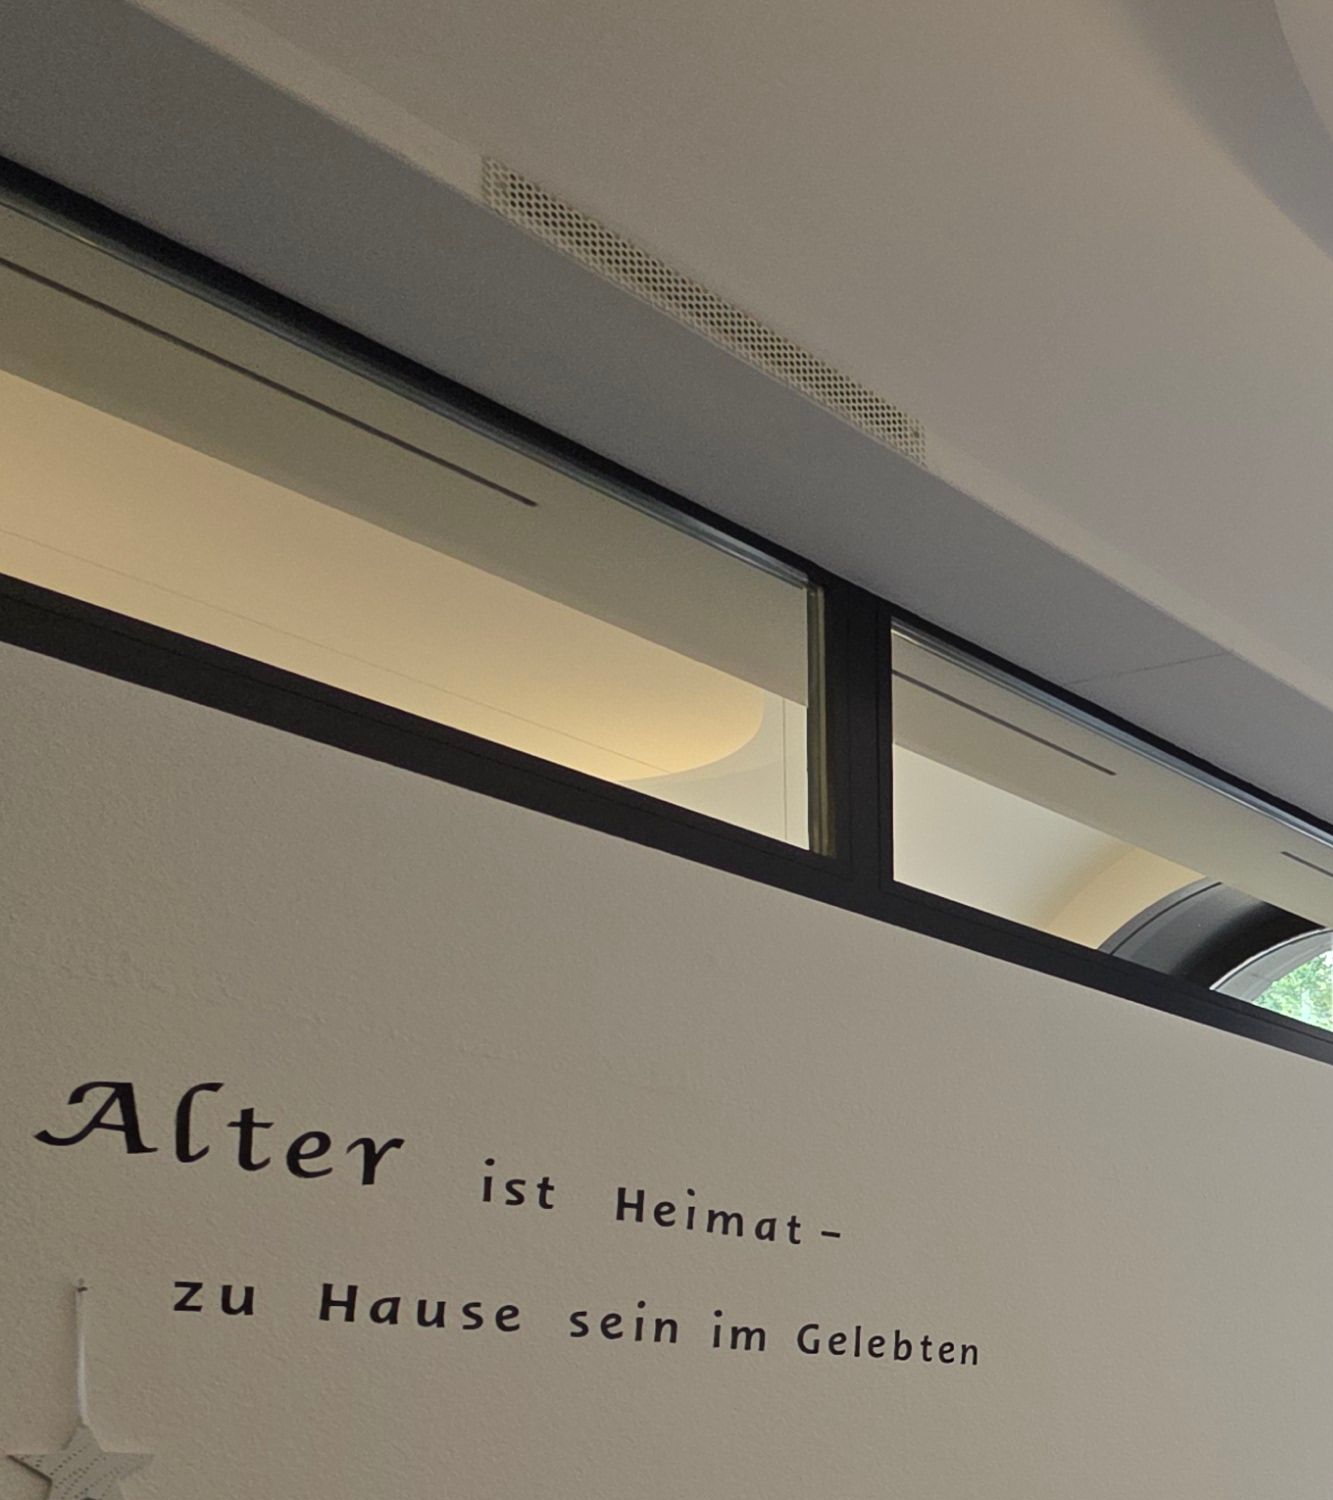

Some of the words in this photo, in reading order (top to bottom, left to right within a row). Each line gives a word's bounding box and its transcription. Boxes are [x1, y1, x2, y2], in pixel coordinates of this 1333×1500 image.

[34, 1080, 406, 1186] Alter
[482, 1157, 556, 1210] ist
[173, 1280, 256, 1316] zu
[318, 1282, 522, 1334] Hause
[568, 1300, 680, 1344] sein
[712, 1309, 767, 1352] im
[796, 1323, 980, 1367] Gelebten
